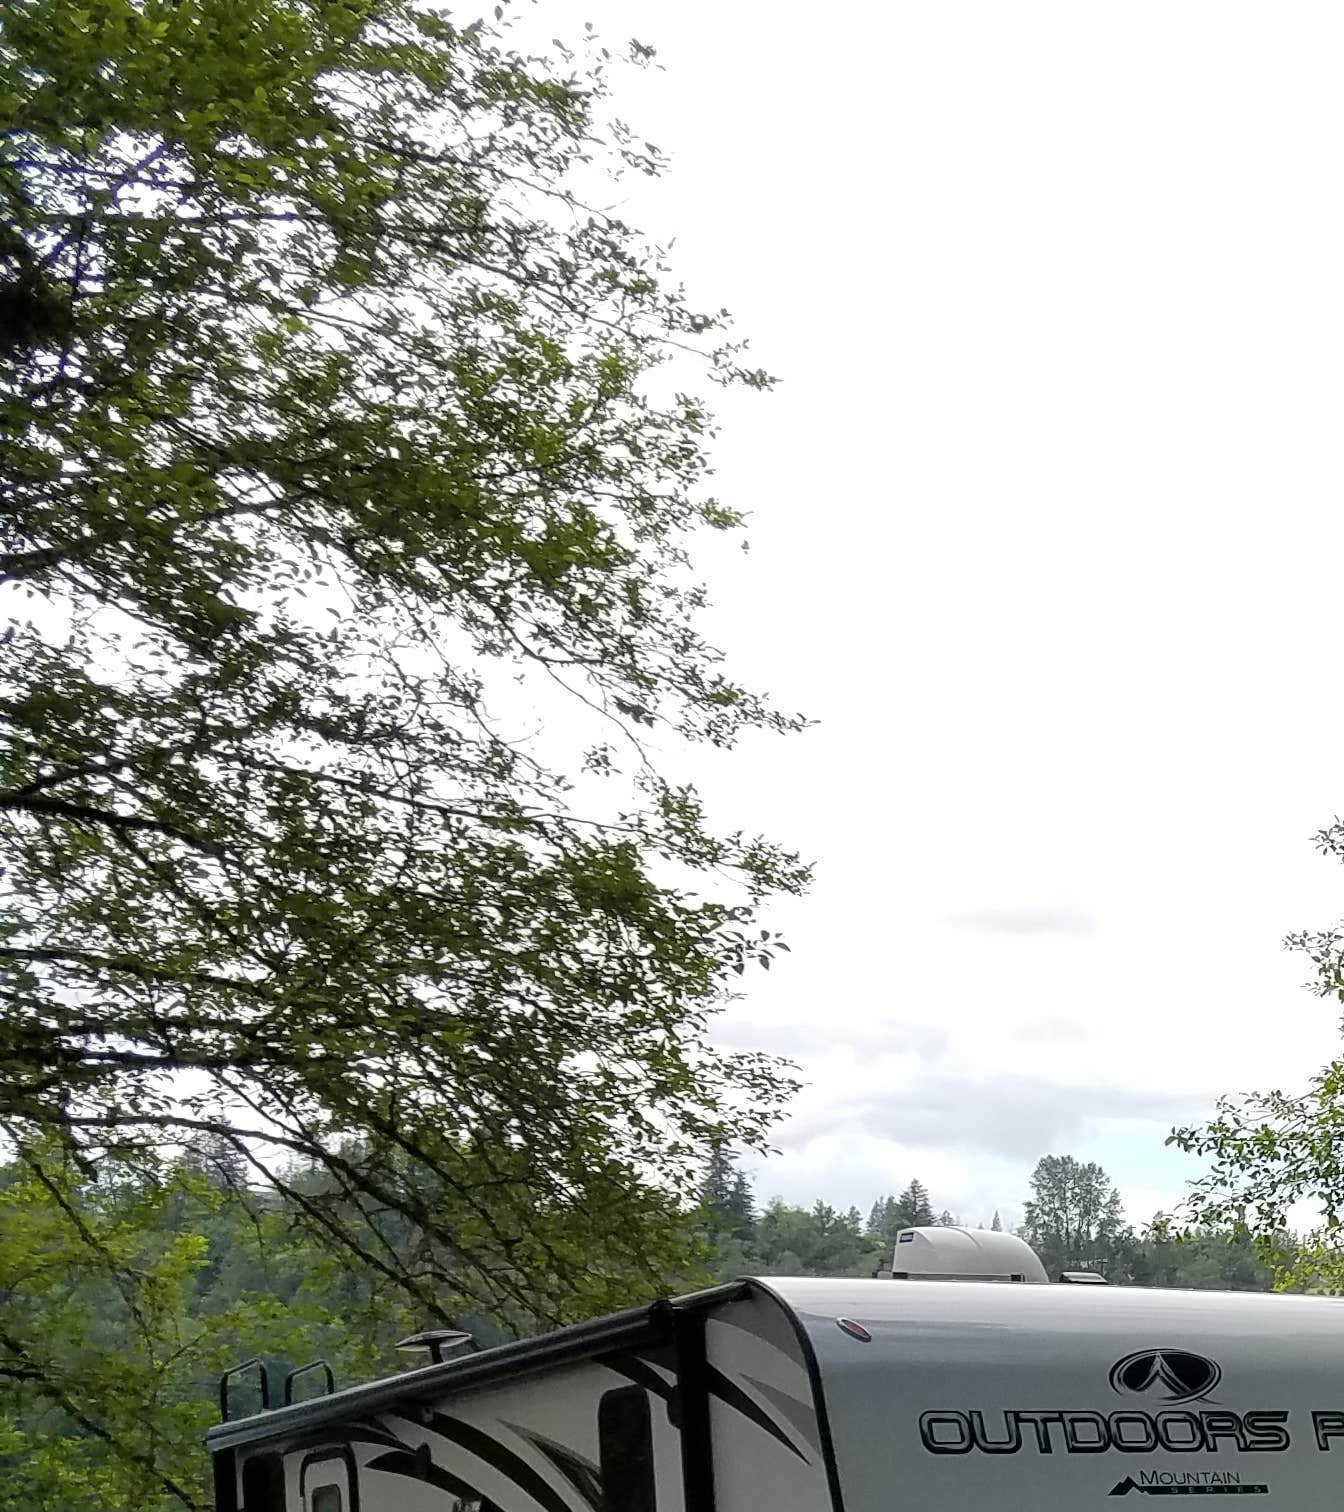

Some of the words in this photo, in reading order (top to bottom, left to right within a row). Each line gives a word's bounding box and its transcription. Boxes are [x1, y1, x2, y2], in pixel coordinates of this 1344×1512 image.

[919, 1410, 1291, 1455] OUTDOORS
[1139, 1470, 1241, 1485] MOUNTAIN
[1169, 1485, 1263, 1495] SERIES
